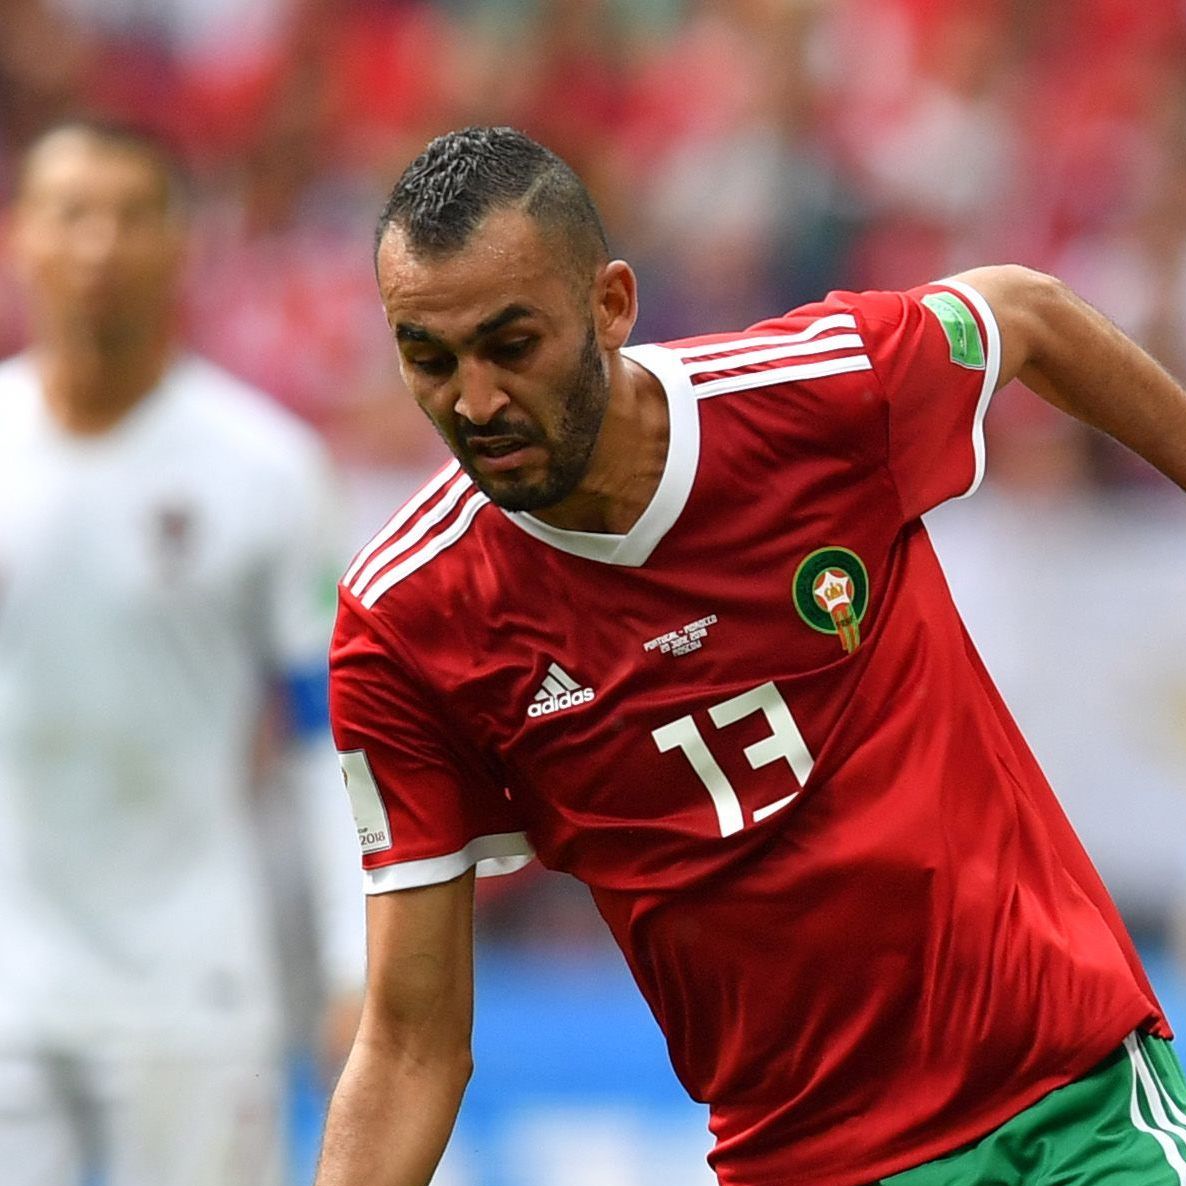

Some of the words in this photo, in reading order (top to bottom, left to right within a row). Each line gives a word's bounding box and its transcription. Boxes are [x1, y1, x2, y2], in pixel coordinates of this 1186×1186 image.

[527, 687, 595, 717] adidas
[651, 681, 815, 838] 13
[359, 831, 385, 846] 2018
